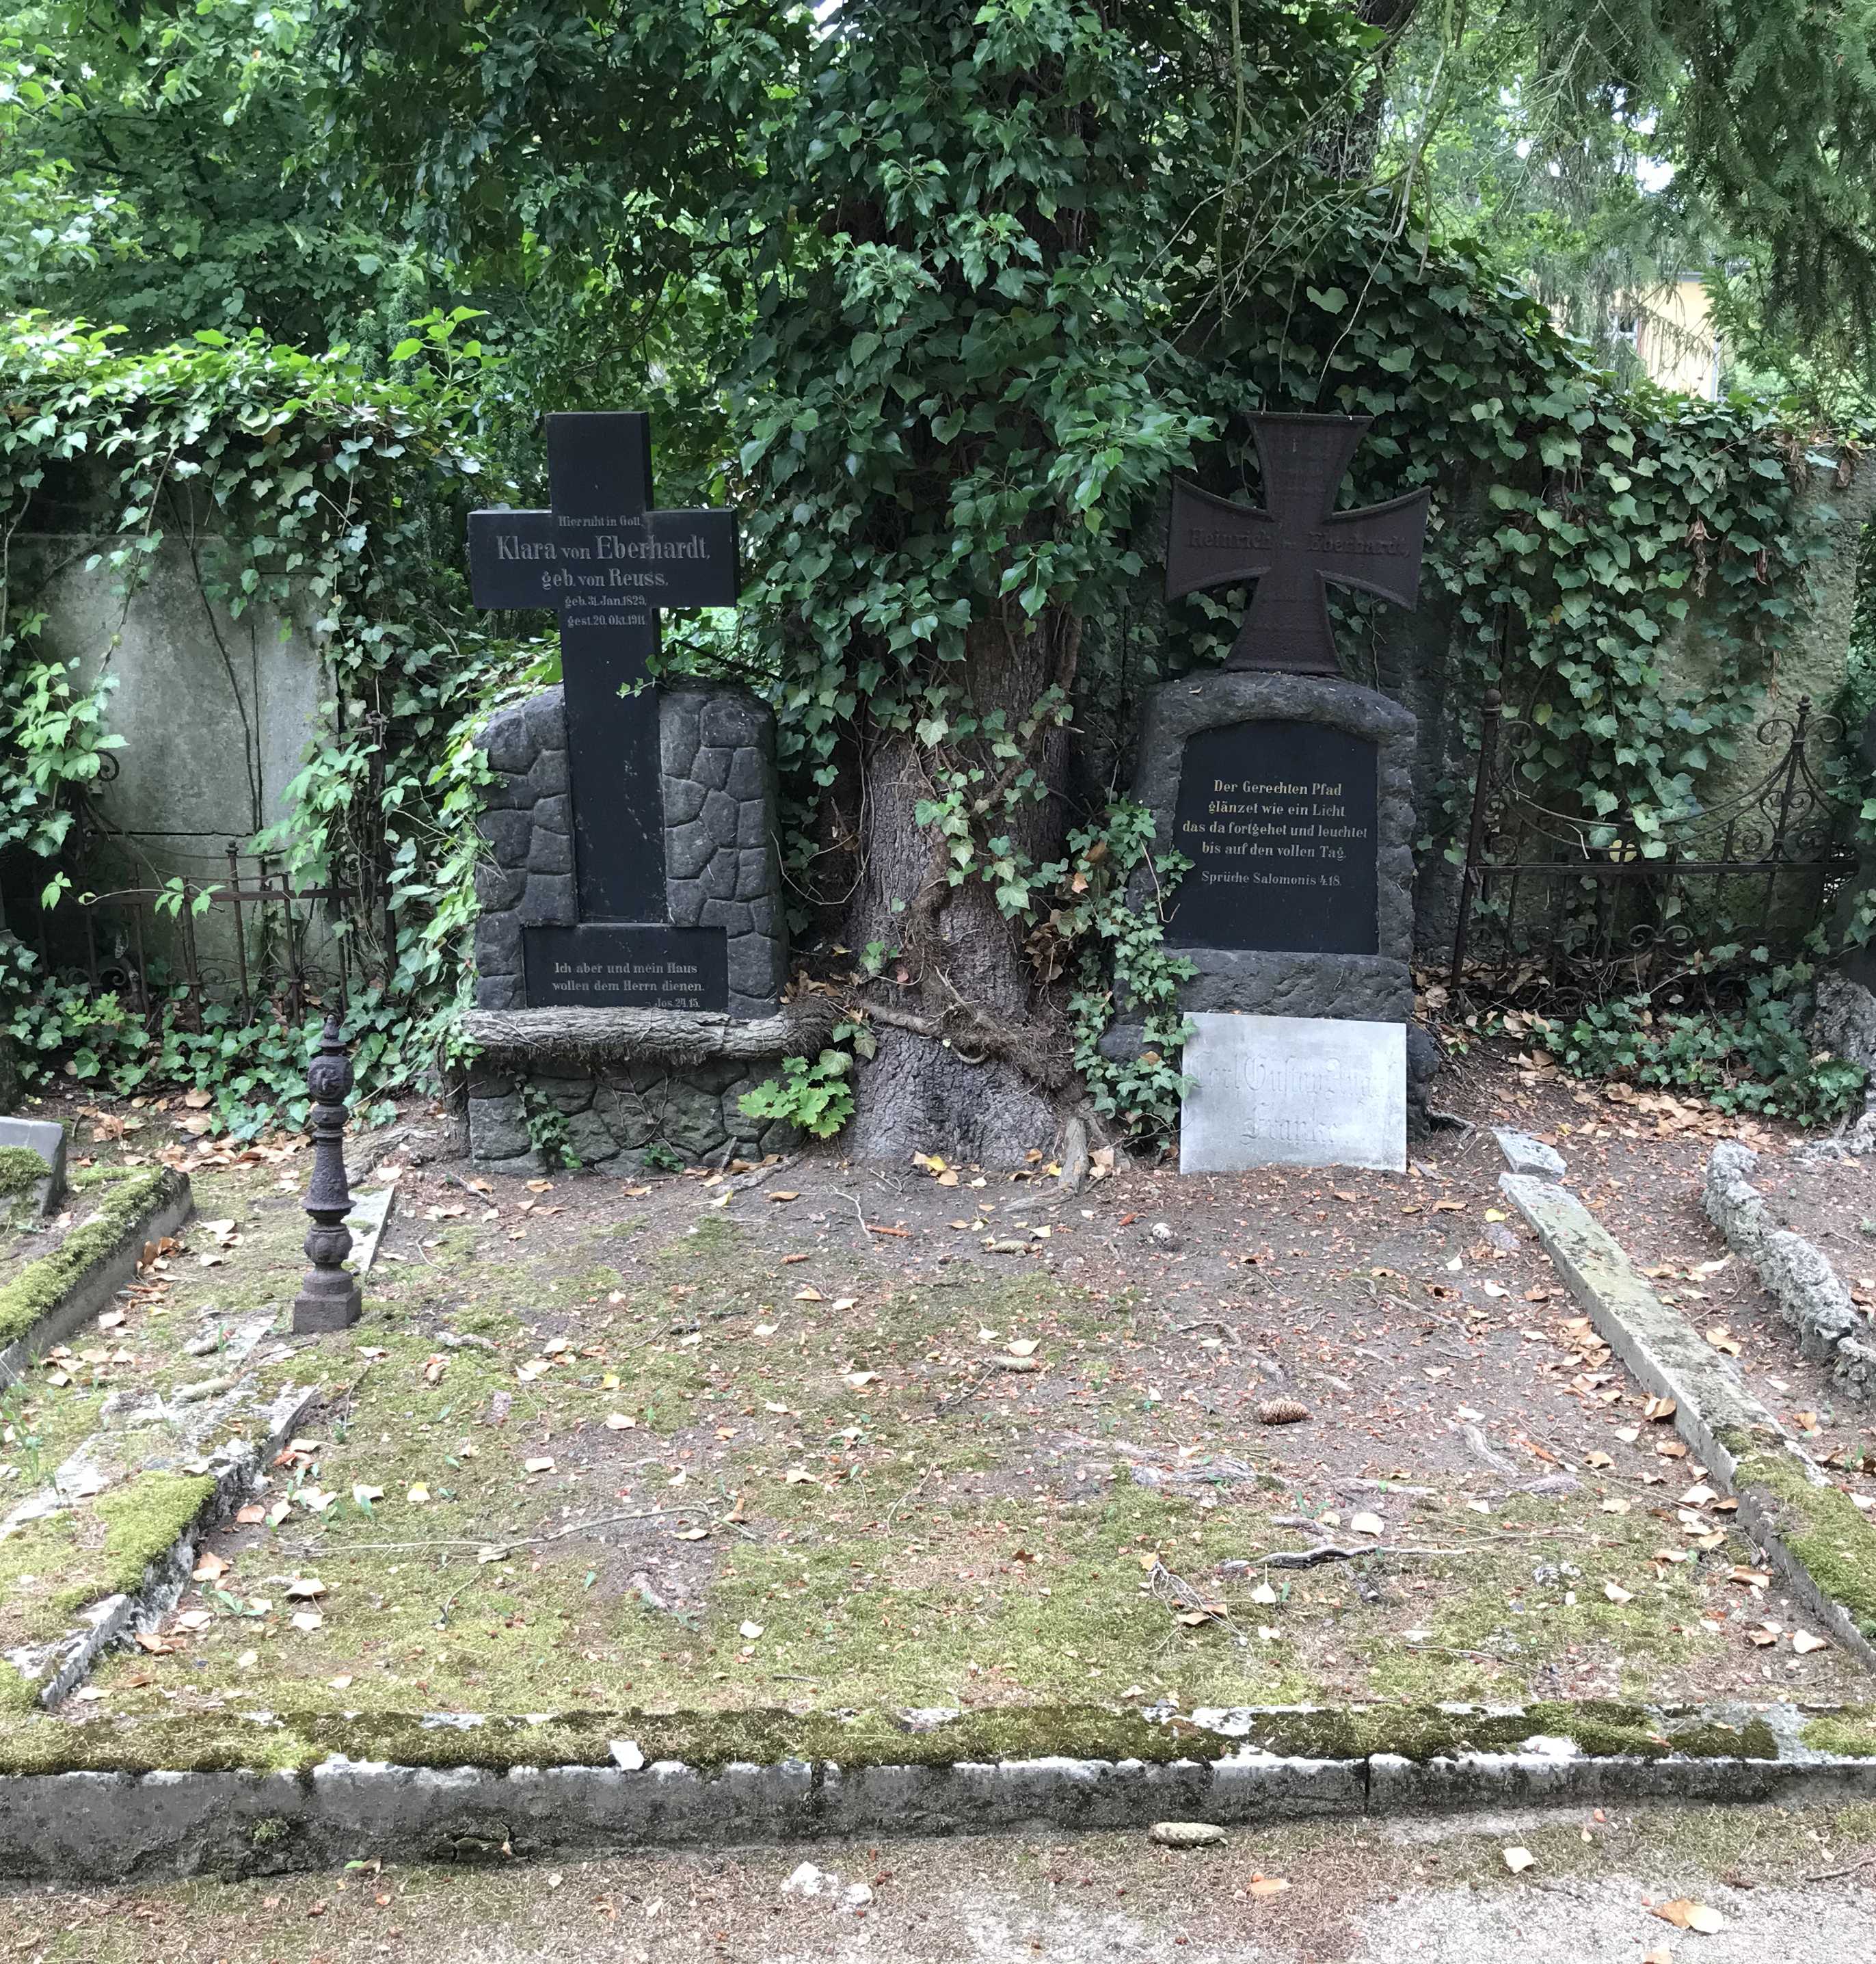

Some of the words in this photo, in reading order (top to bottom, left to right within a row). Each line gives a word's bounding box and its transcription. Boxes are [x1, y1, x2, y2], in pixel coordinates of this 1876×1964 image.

[557, 515, 581, 527] Hier
[582, 515, 605, 527] ruht
[606, 516, 618, 527] in
[496, 535, 557, 560] Klara
[561, 546, 591, 559] von
[595, 534, 710, 560] Eberhardt,
[578, 574, 606, 587] von
[1214, 779, 1238, 793] Der
[1242, 780, 1308, 795] Gerechten
[1311, 783, 1342, 797] Pfad
[1208, 800, 1259, 814] glänzet
[1262, 803, 1285, 814] wie
[1287, 804, 1309, 816] ein
[1182, 820, 1205, 833] das
[1209, 821, 1226, 834] da
[1228, 821, 1287, 837] fortgehet
[1290, 824, 1315, 837] und
[1318, 824, 1367, 838] leuchtet
[1202, 841, 1222, 854] bis
[1224, 842, 1248, 855] auf
[1250, 842, 1274, 856] den
[1276, 844, 1315, 858] vollen
[1201, 870, 1250, 886] Sprüche
[1252, 872, 1317, 886] Salomonis
[554, 961, 572, 974] Ich
[576, 961, 603, 974] aber
[607, 961, 631, 974] und
[633, 961, 664, 974] mein
[667, 962, 698, 974] Haus
[552, 979, 590, 992] wollen
[593, 980, 619, 992] dem
[624, 980, 658, 992] Herrn
[662, 980, 705, 992] dienen.
